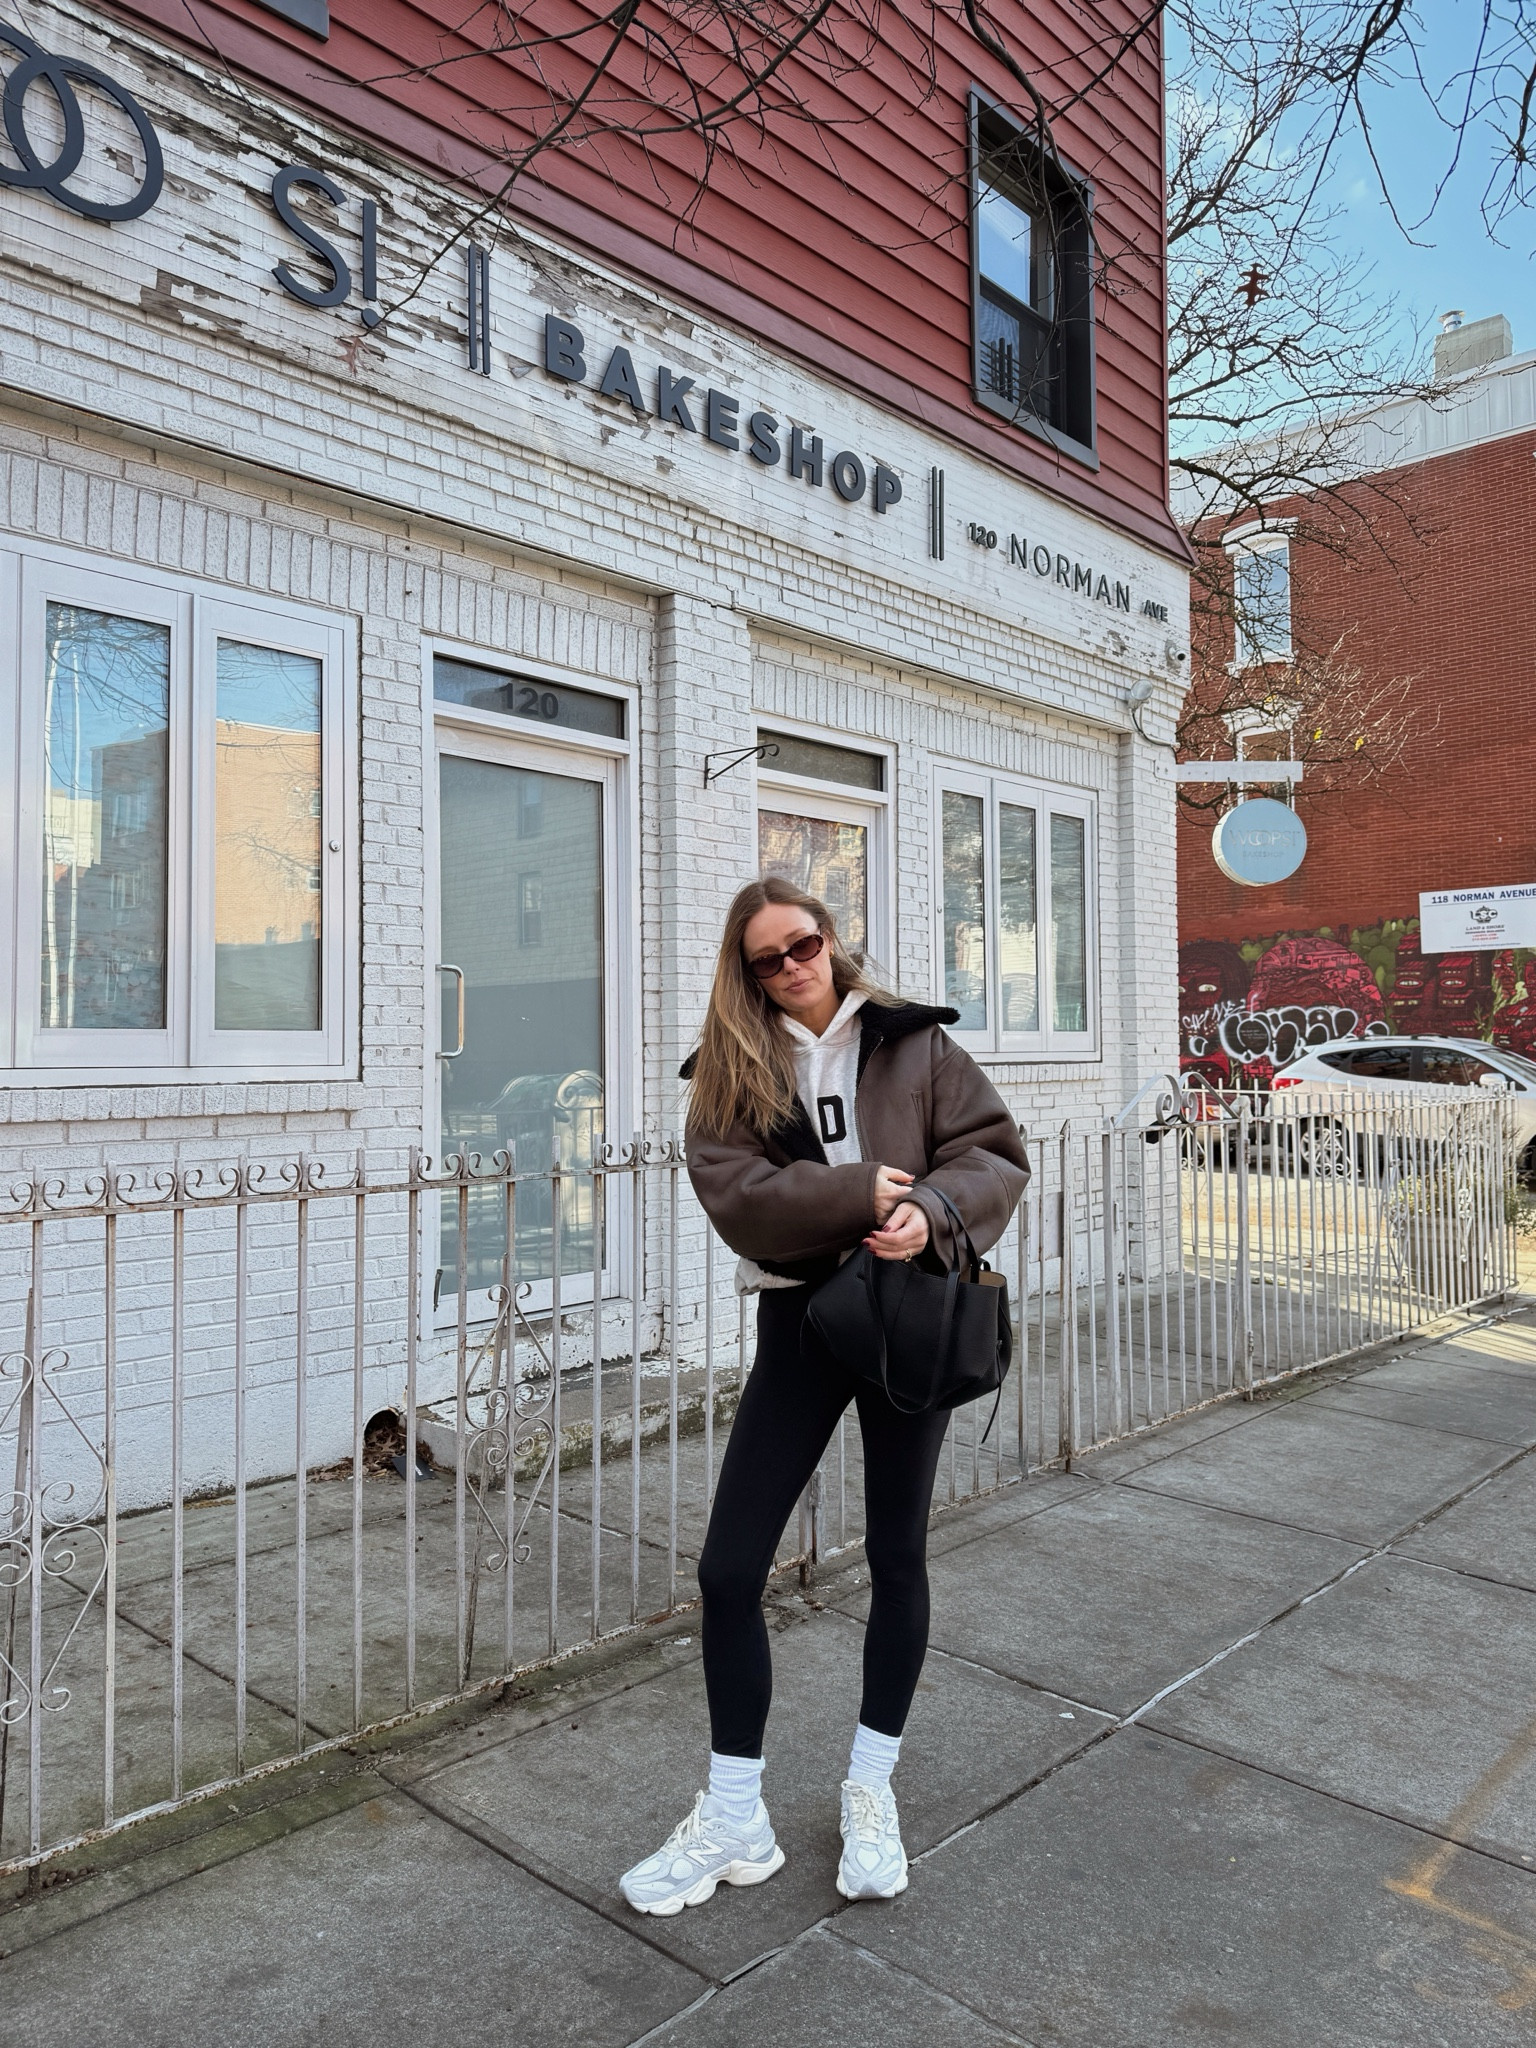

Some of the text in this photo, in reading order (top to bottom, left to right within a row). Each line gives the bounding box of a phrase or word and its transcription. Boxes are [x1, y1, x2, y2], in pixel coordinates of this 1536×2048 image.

[545, 313, 903, 515] BAKESHOP
[968, 522, 1169, 623] 120 NORMAN AVE
[496, 682, 559, 719] 120
[1432, 888, 1536, 904] 118 NORMAN AVENUE
[1470, 909, 1498, 922] LSC
[817, 1094, 847, 1144] D
